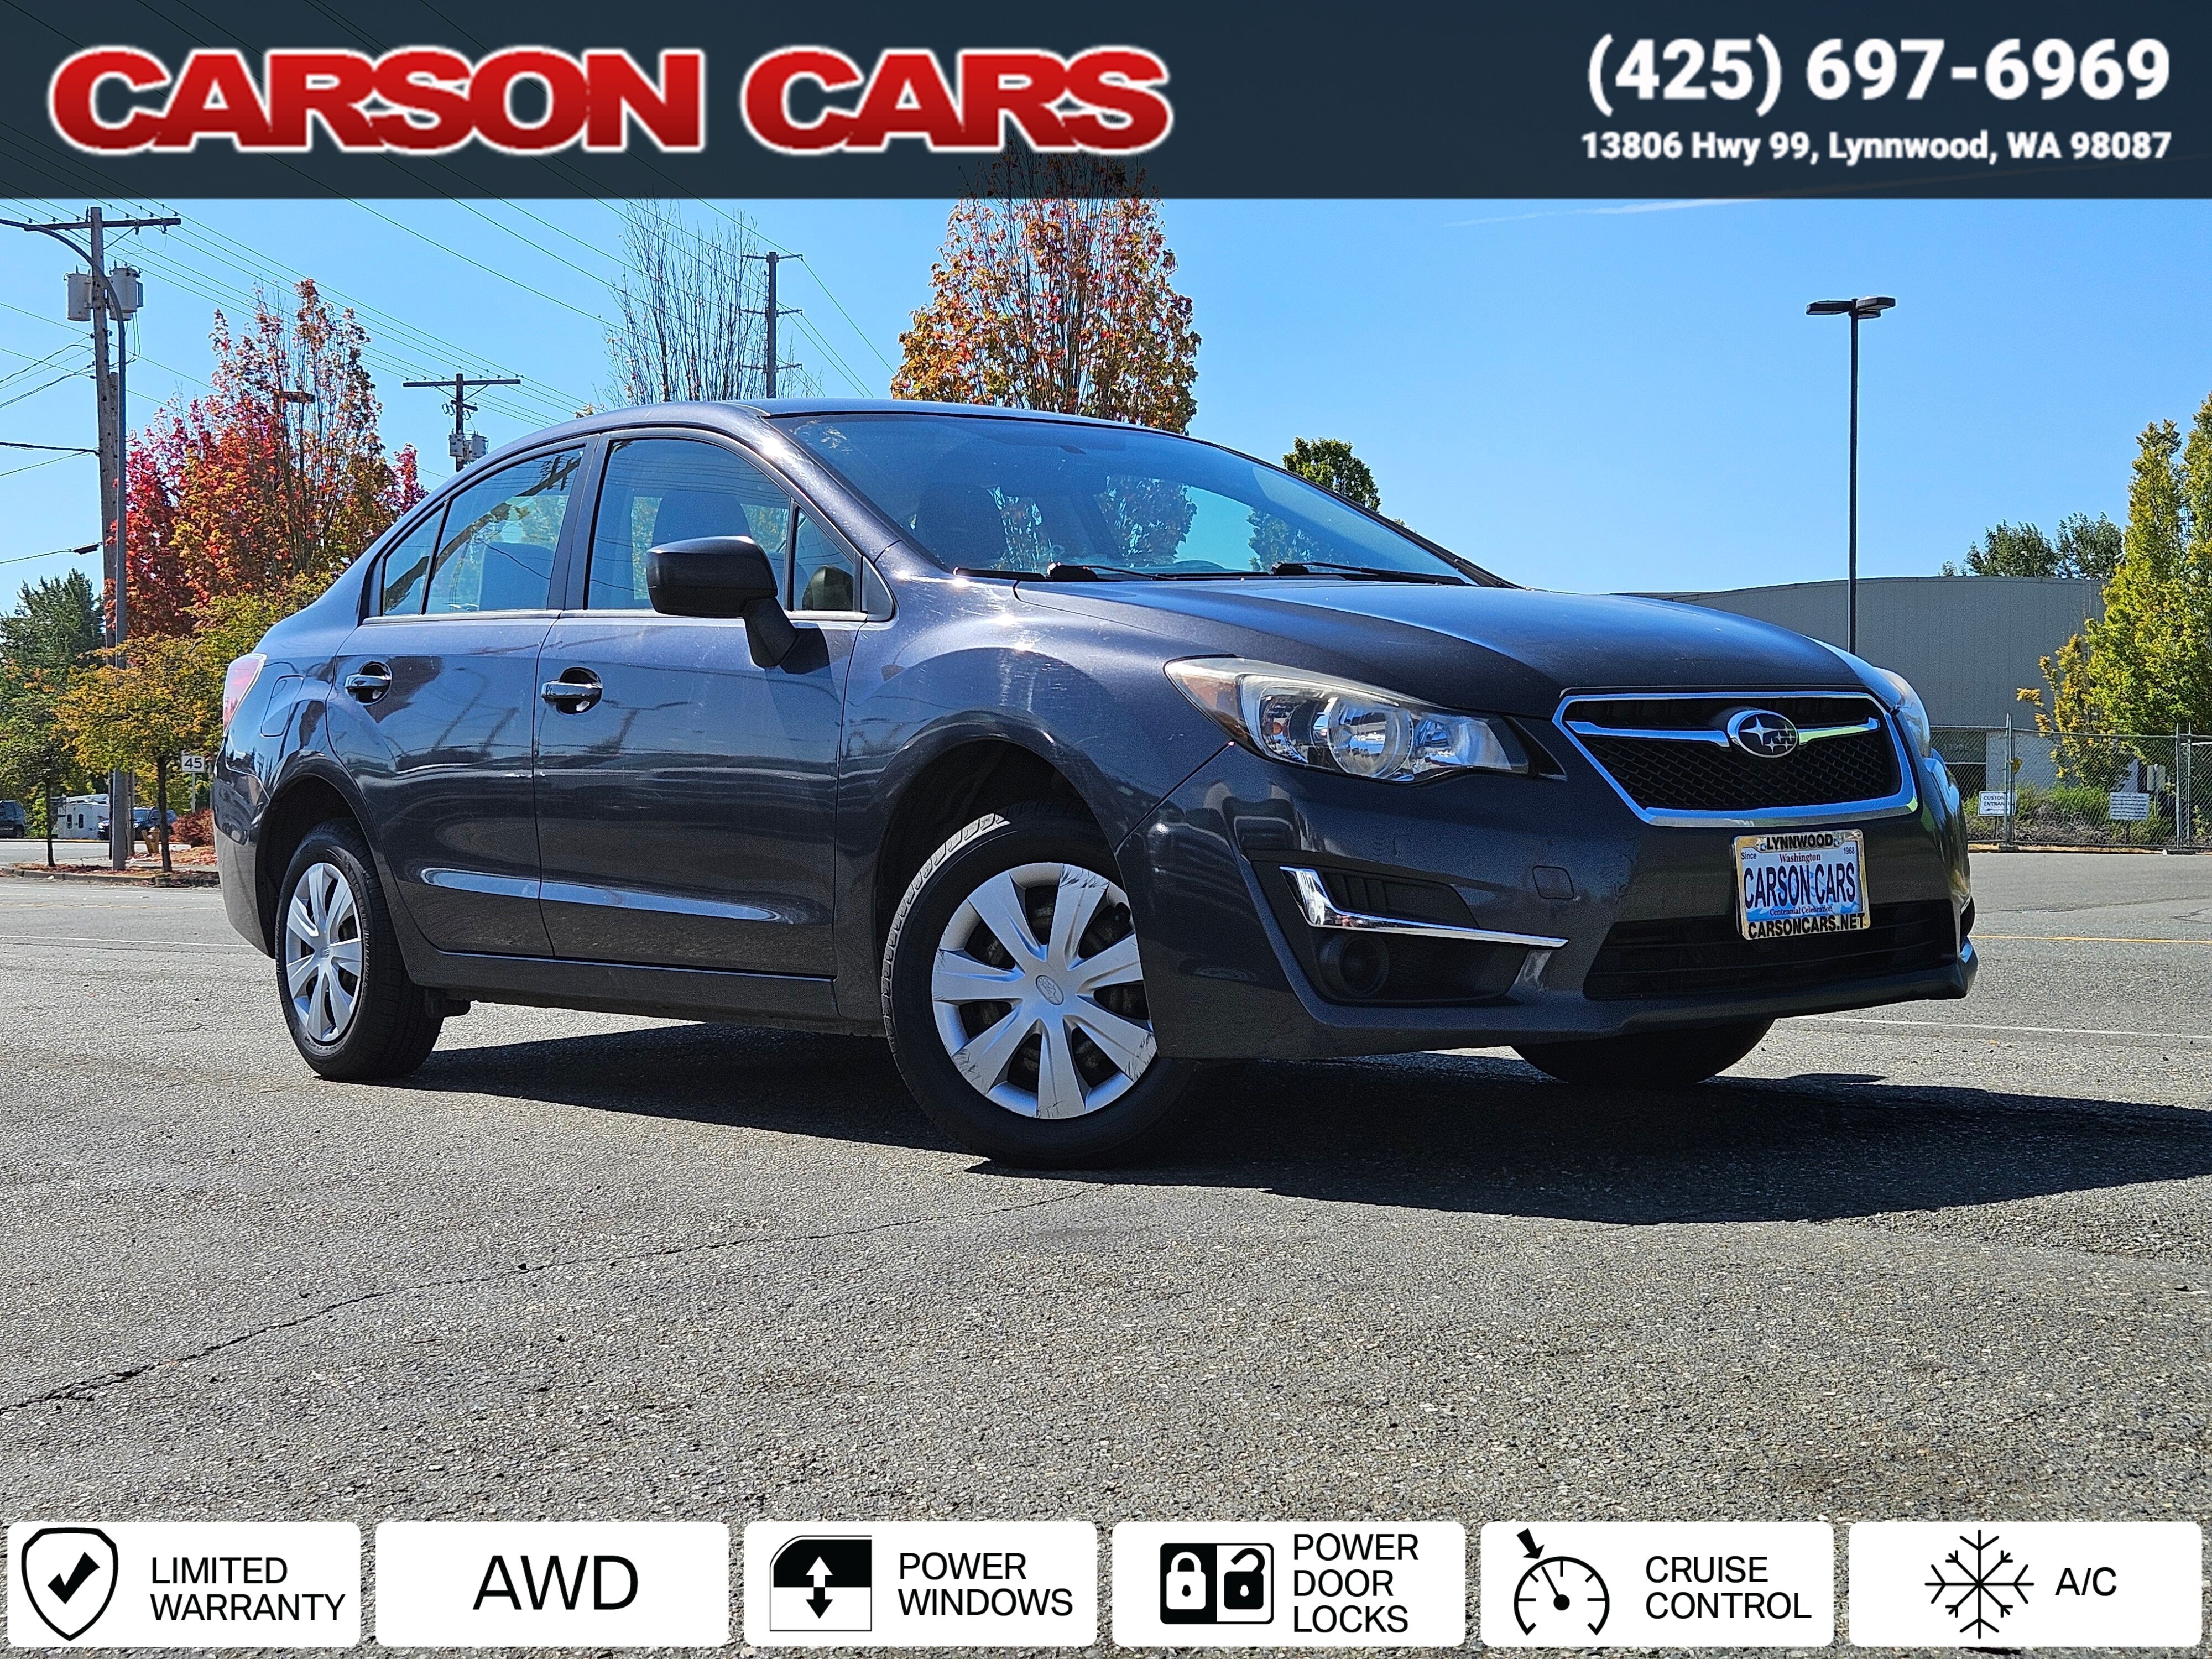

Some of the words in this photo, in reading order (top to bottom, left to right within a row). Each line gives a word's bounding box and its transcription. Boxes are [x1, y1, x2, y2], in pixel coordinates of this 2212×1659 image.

[184, 758, 202, 769] 45
[1766, 833, 1834, 851] LYNNWOOD
[1740, 852, 1757, 860] Since
[1843, 847, 1855, 855] 1968
[1779, 853, 1821, 864] Washington
[1743, 865, 1811, 909] CARSON
[1814, 862, 1855, 905] CARS
[1770, 906, 1801, 916] Centennial
[1801, 905, 1833, 914] Celebration
[1748, 913, 1865, 939] CARSONCARS.NET
